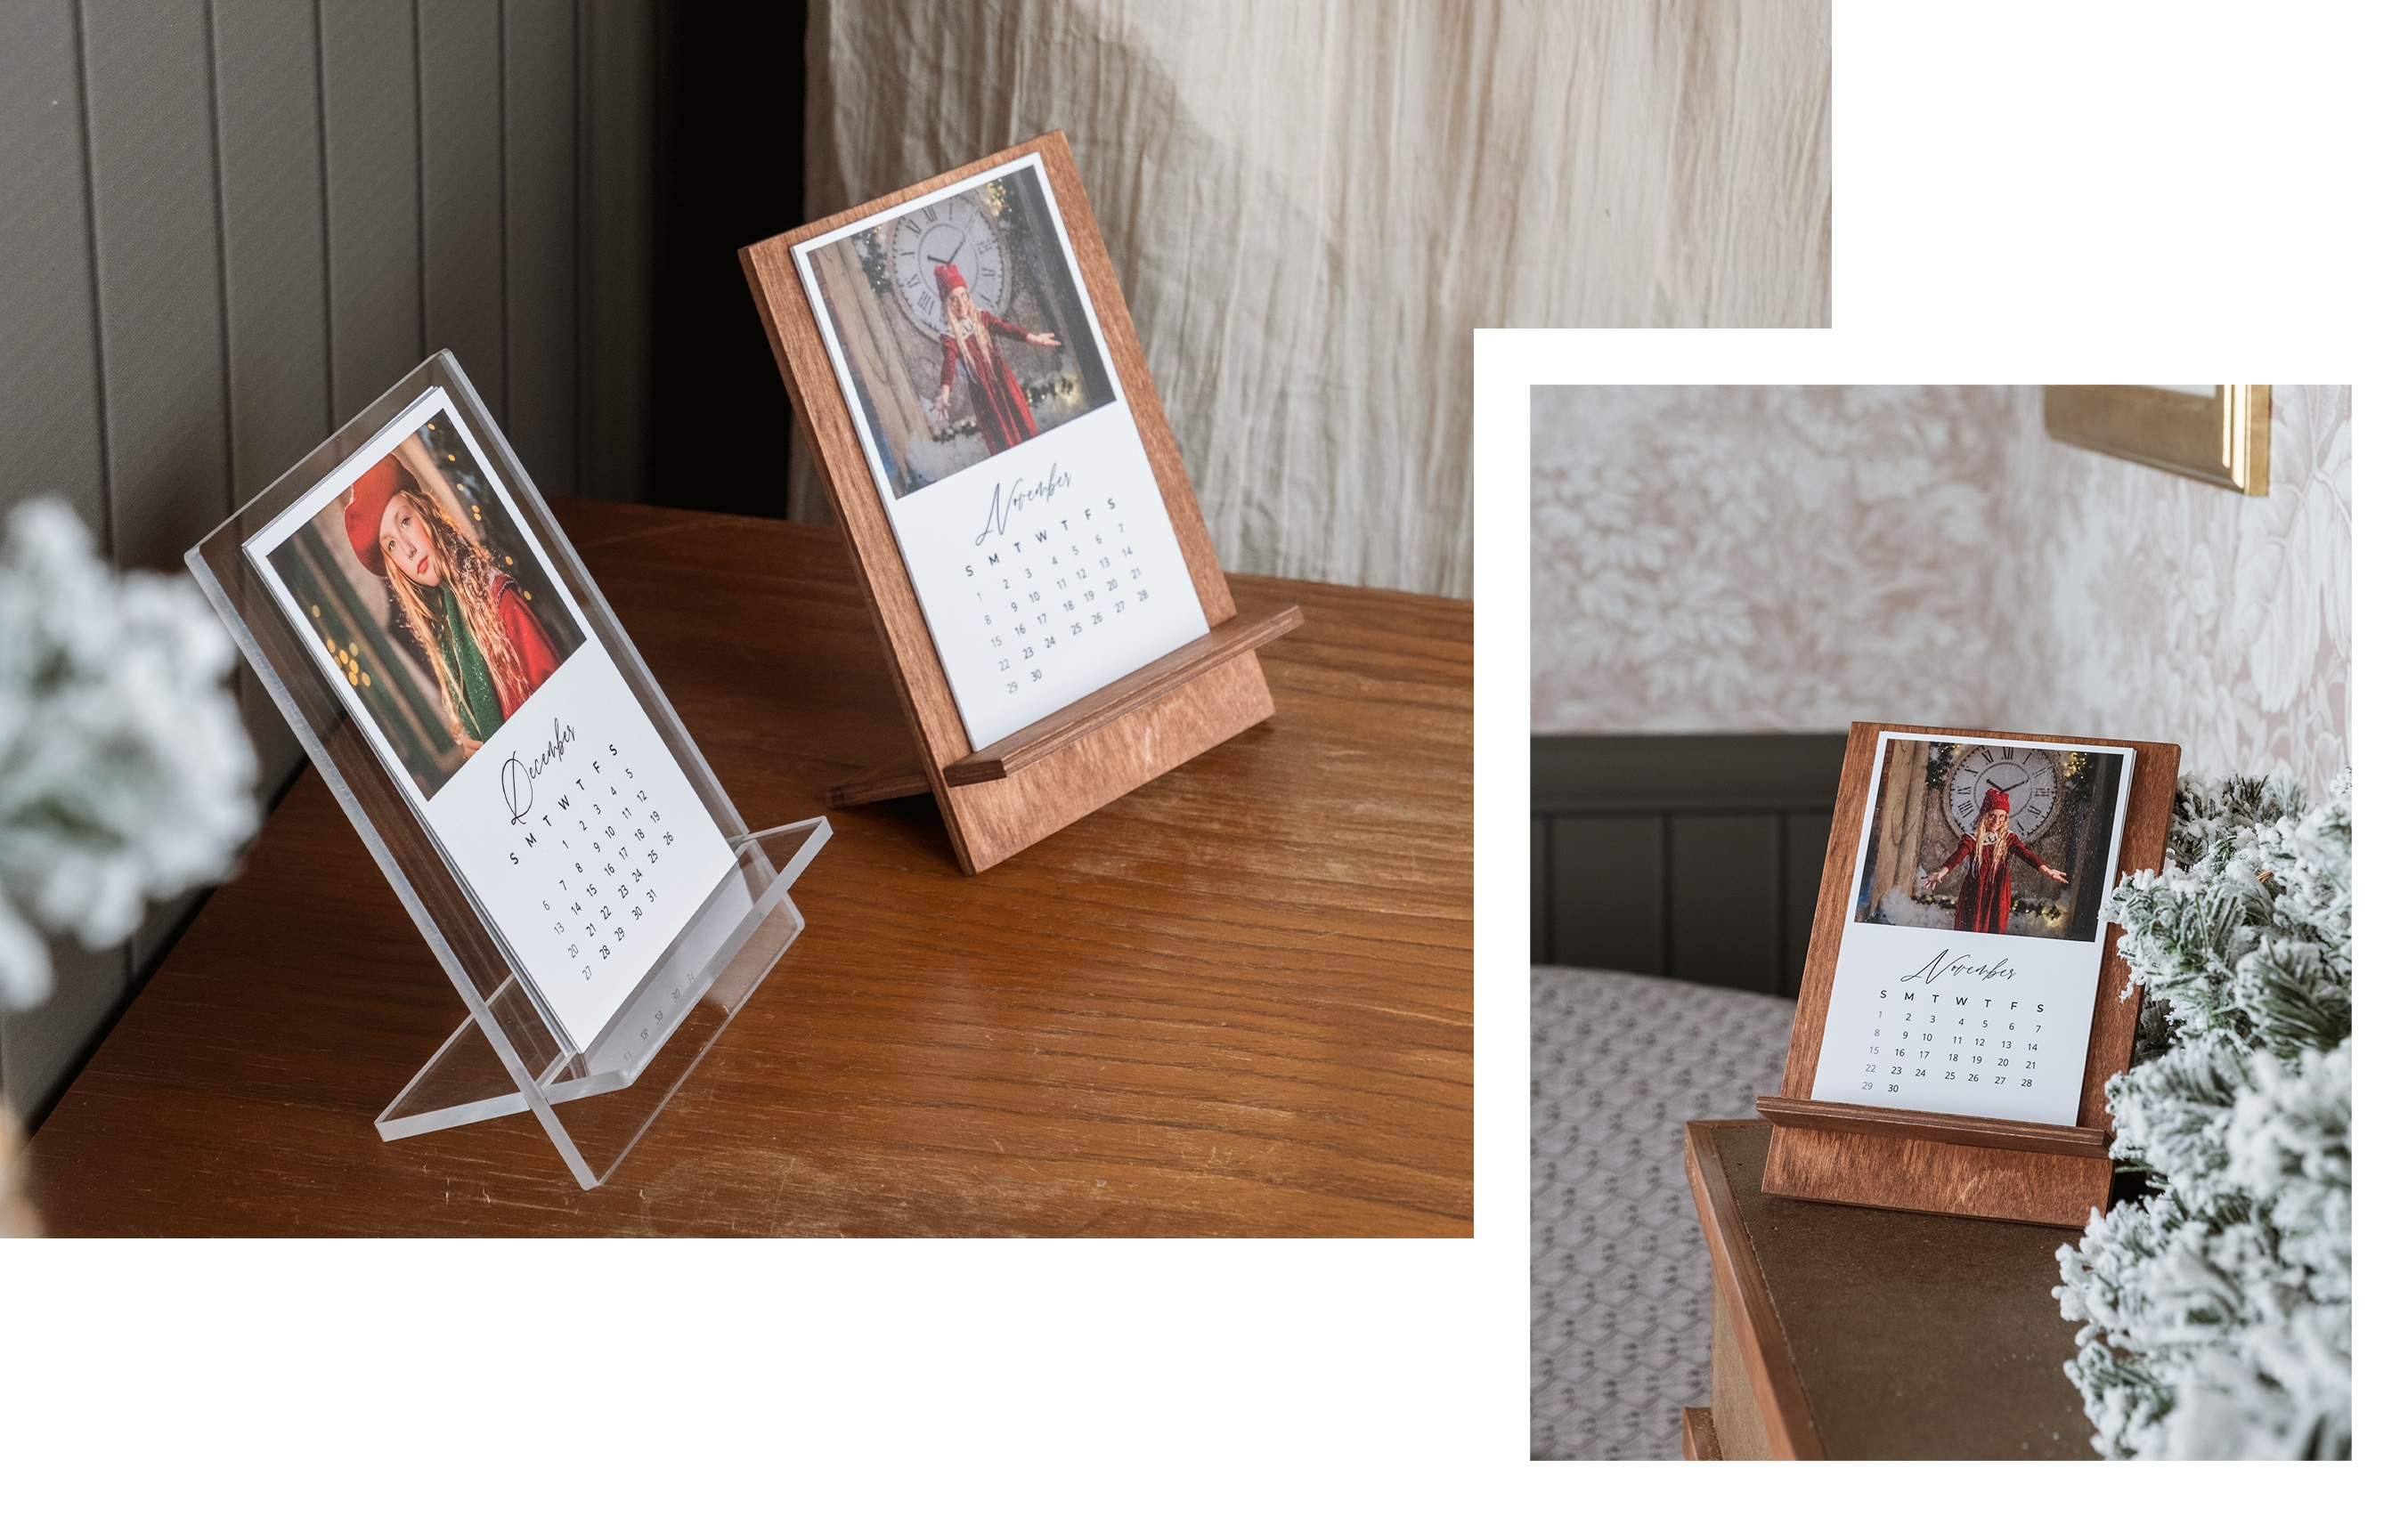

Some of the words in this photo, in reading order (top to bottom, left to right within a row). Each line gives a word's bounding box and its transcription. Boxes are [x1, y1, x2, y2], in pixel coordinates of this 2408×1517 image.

[964, 564, 974, 578] S
[988, 552, 1001, 567] M
[1013, 540, 1021, 554] T
[1034, 529, 1048, 544] W
[1060, 518, 1069, 531] T
[1084, 507, 1092, 521] F
[1106, 497, 1116, 510] S
[975, 462, 1071, 547] November
[976, 591, 982, 602] 1
[1002, 578, 1011, 590] 2
[1024, 567, 1033, 580] 3
[1051, 556, 1059, 565] 4
[1071, 545, 1079, 556] 5
[1094, 533, 1102, 545] 6
[1118, 523, 1124, 533] 7
[984, 614, 992, 626] 8
[1010, 601, 1019, 613] 9
[1029, 590, 1041, 604] 10
[1056, 578, 1068, 590] 11
[1076, 567, 1088, 581] 12
[1099, 556, 1111, 569] 13
[1121, 546, 1134, 558] 14
[990, 635, 1003, 648] 15
[1014, 623, 1027, 637] 16
[1037, 612, 1047, 626] 17
[1062, 599, 1075, 612] 18
[1083, 589, 1095, 603] 19
[1106, 578, 1119, 592] 20
[1130, 567, 1142, 580] 21
[997, 658, 1012, 672] 22
[1021, 645, 1035, 661] 23
[1044, 635, 1056, 650] 24
[1070, 621, 1083, 637] 25
[1090, 611, 1103, 626] 26
[1114, 599, 1125, 614] 27
[1136, 588, 1149, 603] 28
[1006, 680, 1019, 694] 29
[1029, 669, 1043, 683] 30
[501, 718, 575, 826] December
[509, 852, 519, 865] S
[525, 832, 538, 848] M
[541, 814, 552, 827] T
[557, 794, 570, 811] W
[575, 778, 585, 791] T
[592, 760, 600, 775] F
[608, 743, 618, 757] S
[562, 840, 569, 849] 1
[578, 820, 588, 832] 2
[592, 803, 602, 815] 3
[610, 785, 617, 796] 4
[624, 767, 633, 780] 5
[542, 899, 550, 911] 6
[558, 879, 567, 891] 7
[574, 862, 583, 873] 8
[593, 841, 601, 853] 9
[605, 825, 615, 840] 10
[622, 807, 632, 820] 11
[636, 790, 647, 803] 12
[554, 921, 565, 936] 13
[571, 901, 582, 916] 14
[586, 883, 598, 897] 15
[604, 862, 615, 877] 16
[618, 846, 629, 861] 17
[634, 828, 646, 842] 18
[649, 810, 661, 824] 19
[567, 943, 579, 960] 20
[585, 922, 598, 937] 21
[599, 905, 612, 921] 22
[617, 884, 630, 899] 23
[631, 867, 643, 883] 24
[647, 848, 659, 864] 25
[663, 831, 674, 847] 26
[582, 965, 592, 981] 27
[598, 945, 611, 961] 28
[614, 926, 625, 942] 29
[631, 905, 643, 921] 30
[646, 888, 657, 904] 31
[1879, 989, 1887, 999] S
[1904, 992, 1915, 1002] M
[1932, 994, 1940, 1003] T
[1955, 996, 1969, 1006] W
[1984, 998, 1992, 1009] T
[2010, 1001, 2019, 1010] F
[2036, 1003, 2045, 1013] S
[1900, 948, 2017, 985] November
[1869, 1046, 1880, 1055] 15
[1895, 1048, 1906, 1058] 16
[1919, 1051, 1930, 1059] 17
[1948, 1053, 1959, 1062] 18
[1972, 1055, 1983, 1065] 19
[1997, 1058, 2009, 1067] 20
[2025, 1060, 2036, 1070] 21
[1874, 1028, 1881, 1037] 8
[1902, 1031, 1909, 1040] 9
[1922, 1033, 1933, 1042] 10
[1953, 1035, 1963, 1045] 11
[1974, 1037, 1986, 1047] 12
[2001, 1040, 2013, 1050] 13
[2028, 1042, 2038, 1051] 14
[1878, 1010, 1883, 1018] 1
[1905, 1012, 1912, 1022] 2
[1929, 1014, 1936, 1024] 3
[1957, 1018, 1965, 1026] 4
[1981, 1019, 1989, 1028] 5
[2008, 1022, 2015, 1031] 6
[2035, 1024, 2042, 1034] 7
[1861, 1081, 1874, 1091] 29
[1887, 1083, 1900, 1093] 30
[1865, 1063, 1876, 1073] 22
[1891, 1066, 1903, 1075] 23
[1915, 1067, 1926, 1077] 24
[1944, 1071, 1956, 1081] 25
[1967, 1073, 1980, 1083] 26
[1994, 1075, 2006, 1085] 27
[2021, 1078, 2033, 1088] 28
